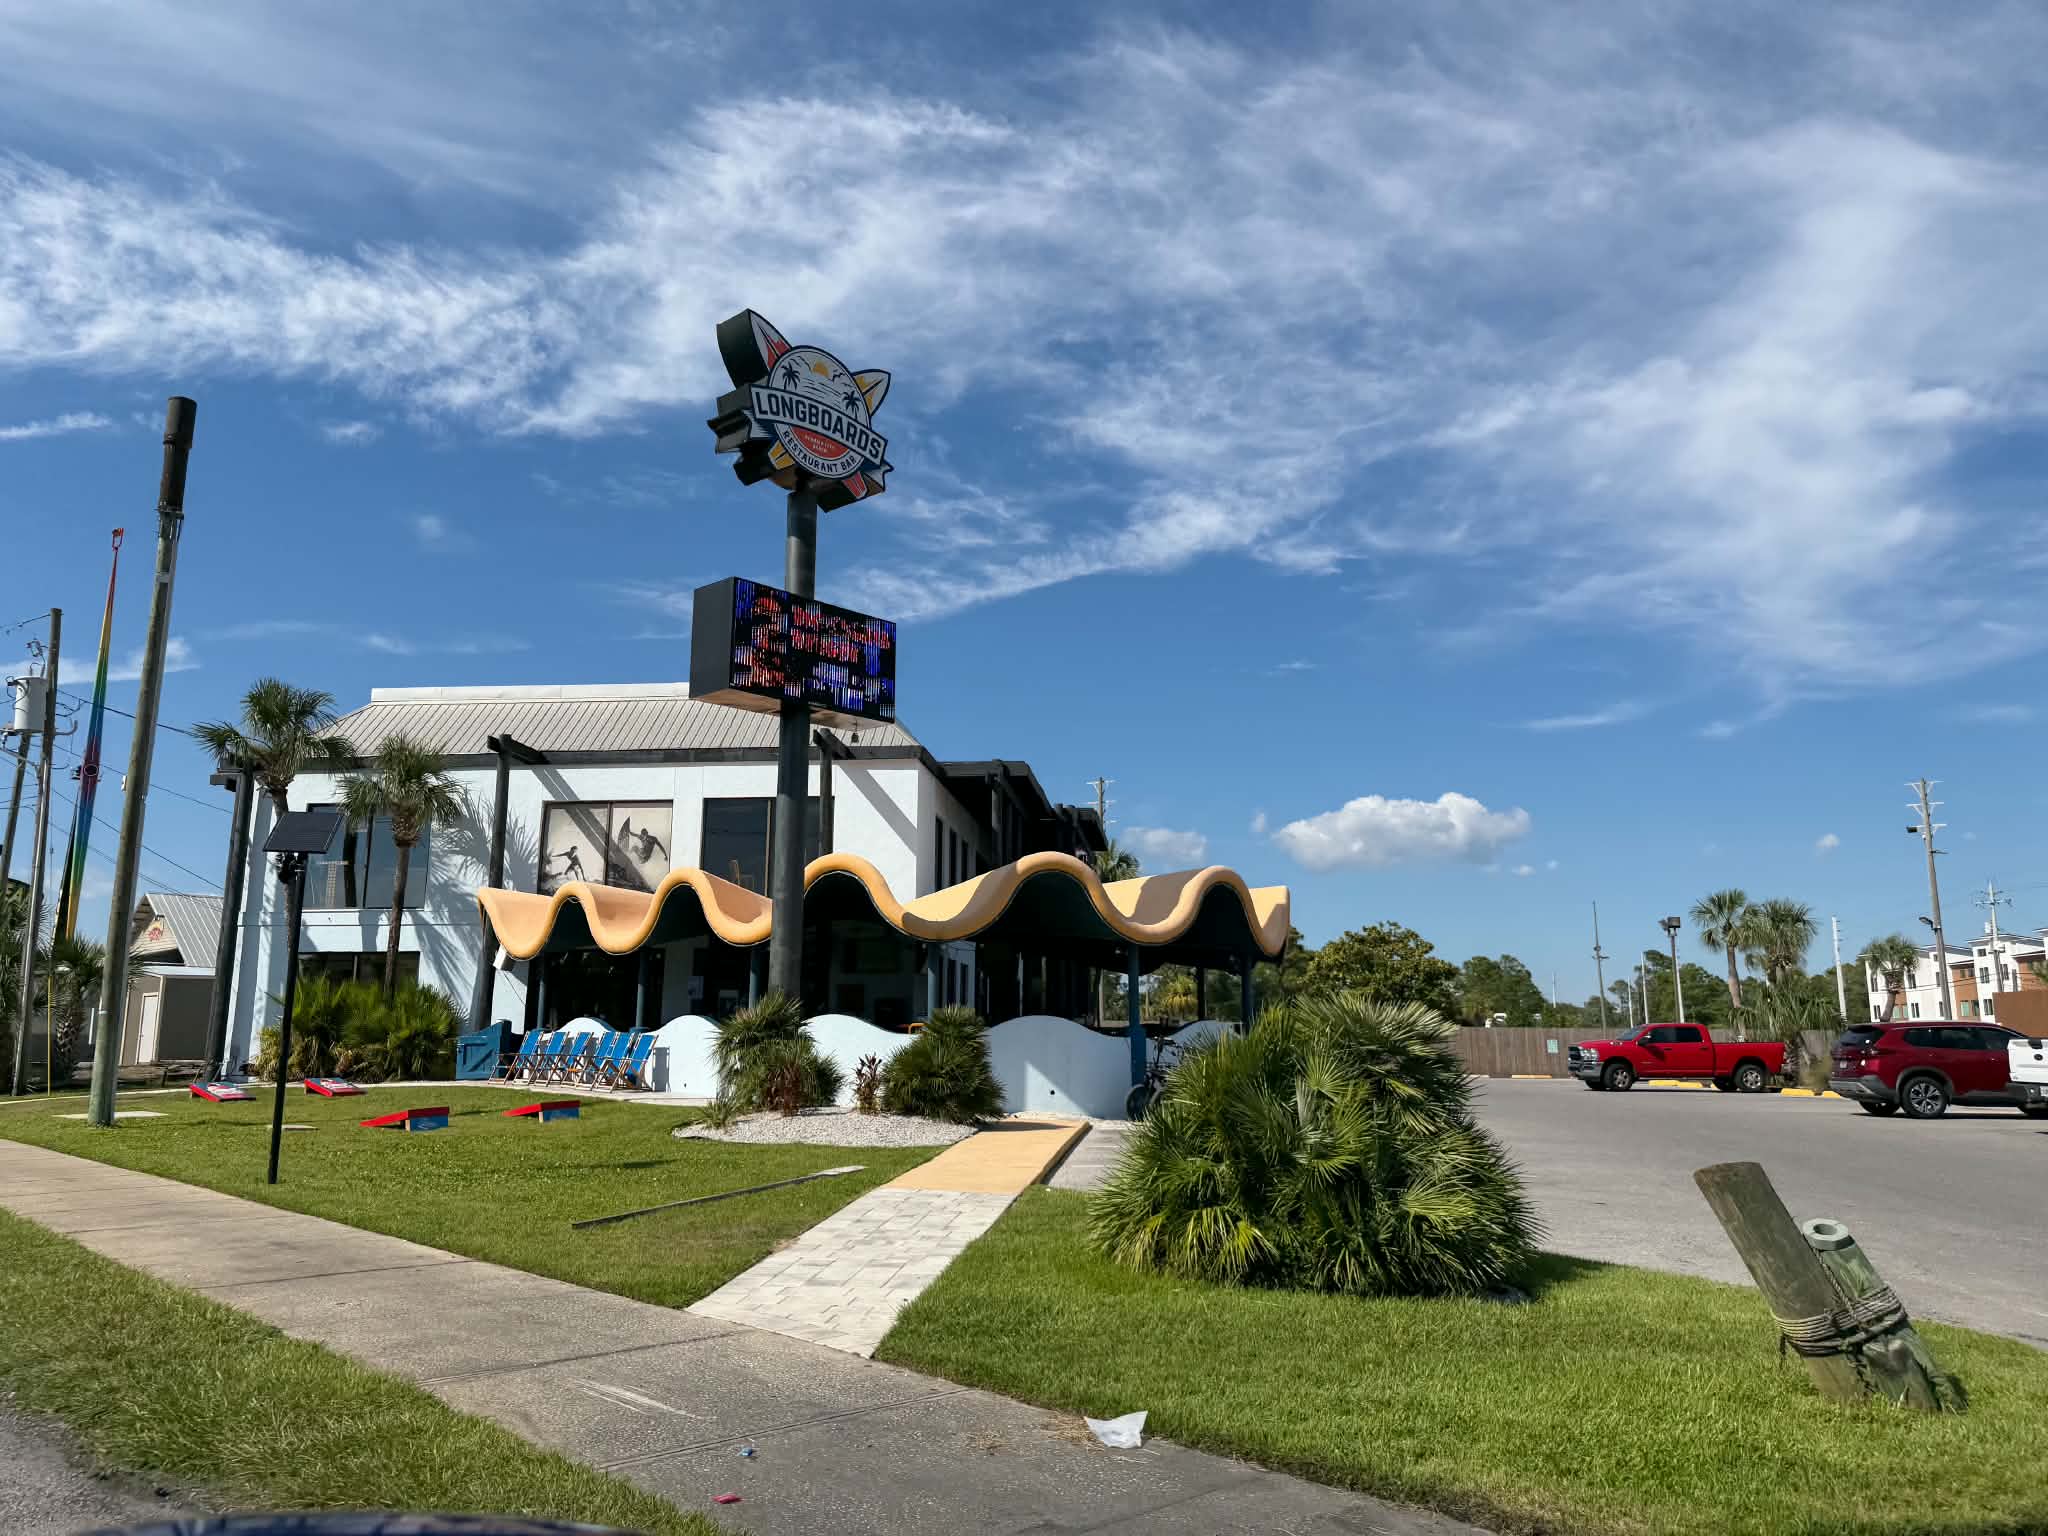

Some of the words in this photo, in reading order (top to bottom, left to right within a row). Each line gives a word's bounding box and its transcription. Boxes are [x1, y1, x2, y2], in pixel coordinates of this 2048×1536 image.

[755, 391, 882, 460] LONGBOARDS
[783, 431, 838, 473] RESTAURANT
[840, 455, 857, 471] BAR
